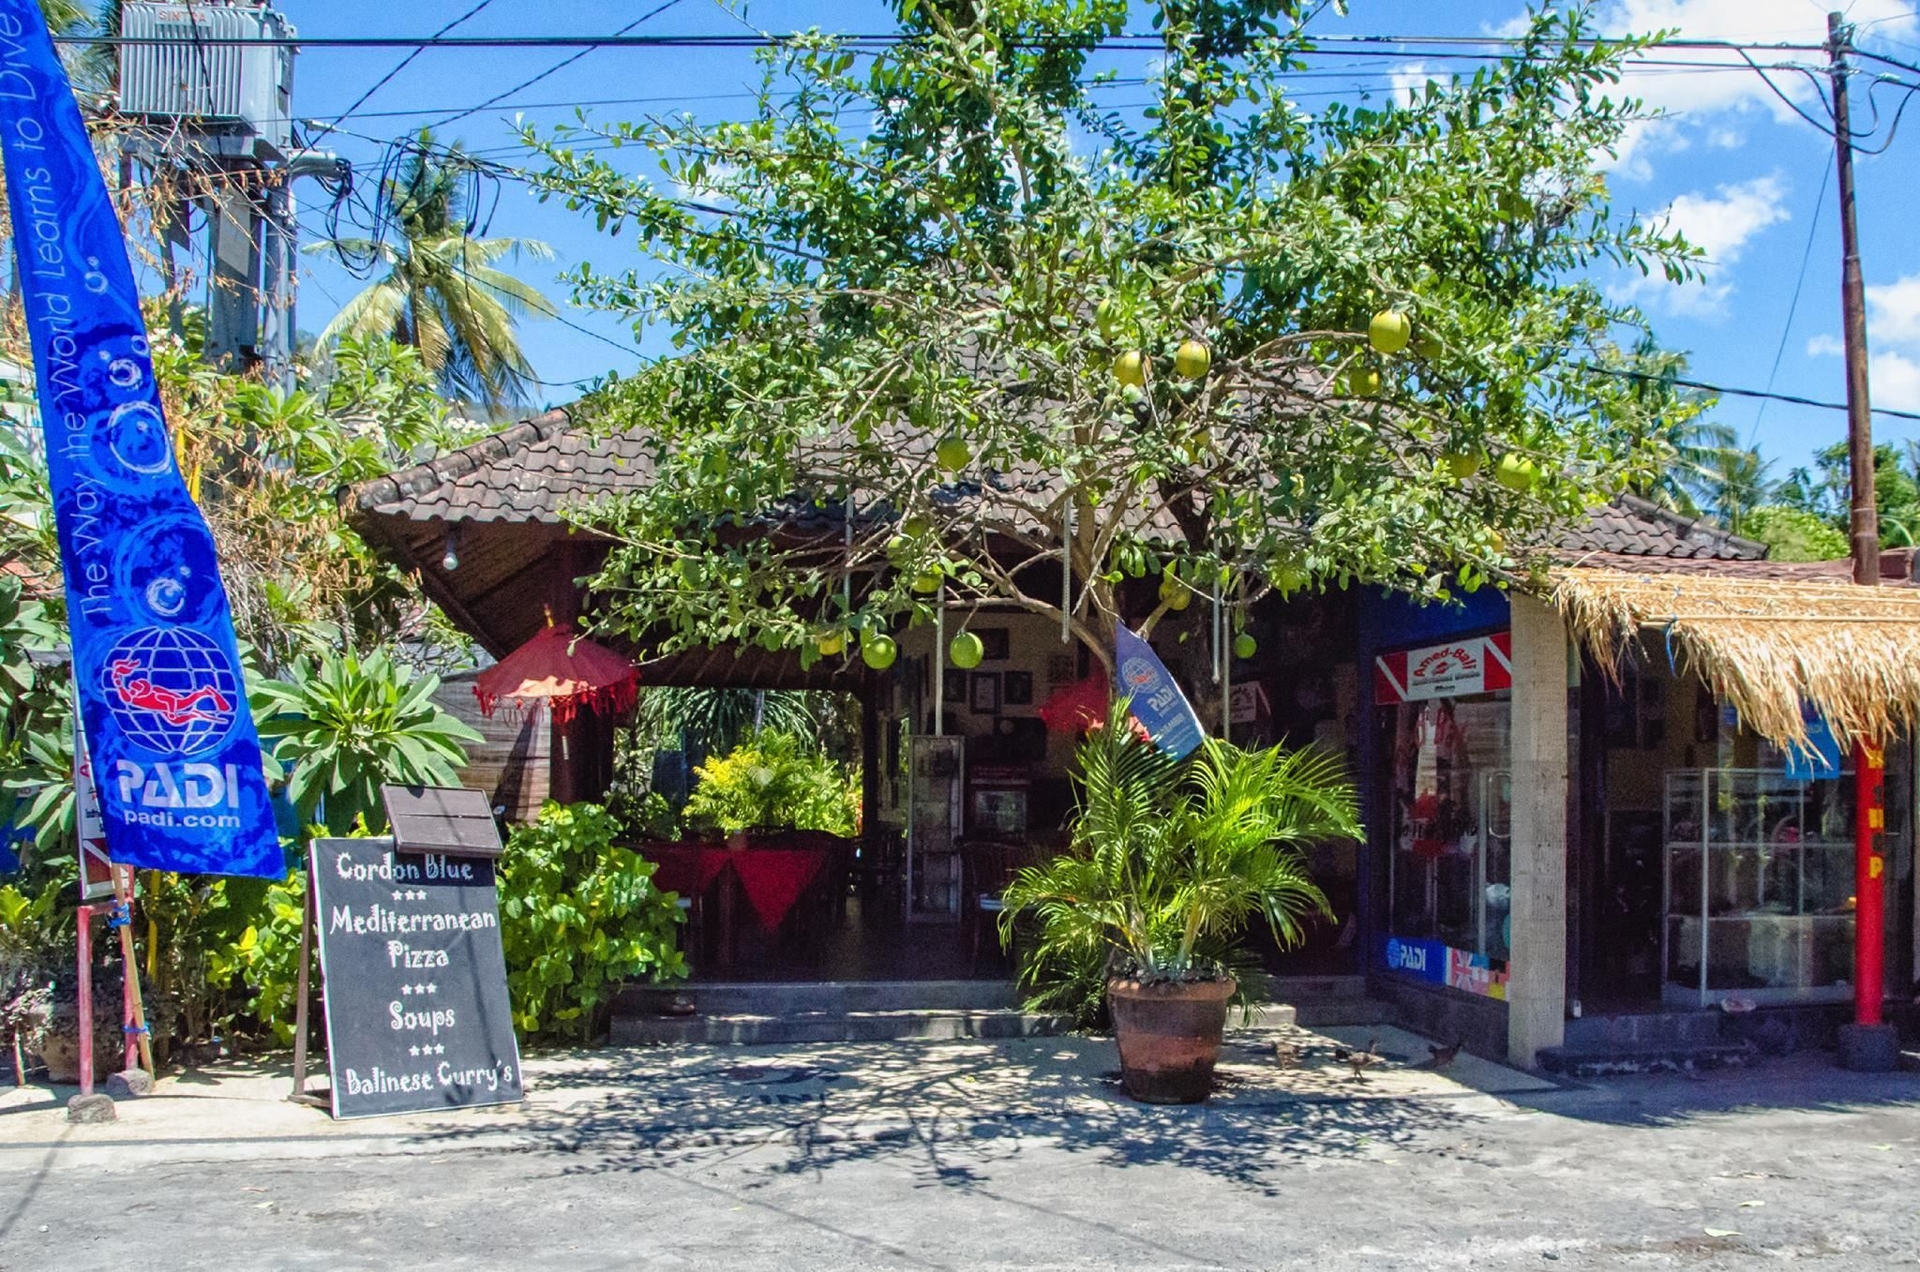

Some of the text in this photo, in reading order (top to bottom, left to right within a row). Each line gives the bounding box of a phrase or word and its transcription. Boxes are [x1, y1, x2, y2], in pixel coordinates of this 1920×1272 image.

[0, 12, 113, 622] The Way the World Learns to Dive
[1413, 647, 1478, 677] Amed-Bali
[1147, 685, 1176, 713] PADI
[116, 759, 239, 808] PADI
[124, 809, 241, 828] padi.com
[336, 852, 474, 881] Cordon Blue
[329, 903, 496, 935] Mediterranean
[387, 940, 449, 968] Pizza
[1400, 944, 1427, 971] PADI
[389, 1000, 456, 1036] Soups
[345, 1066, 435, 1095] Balinese
